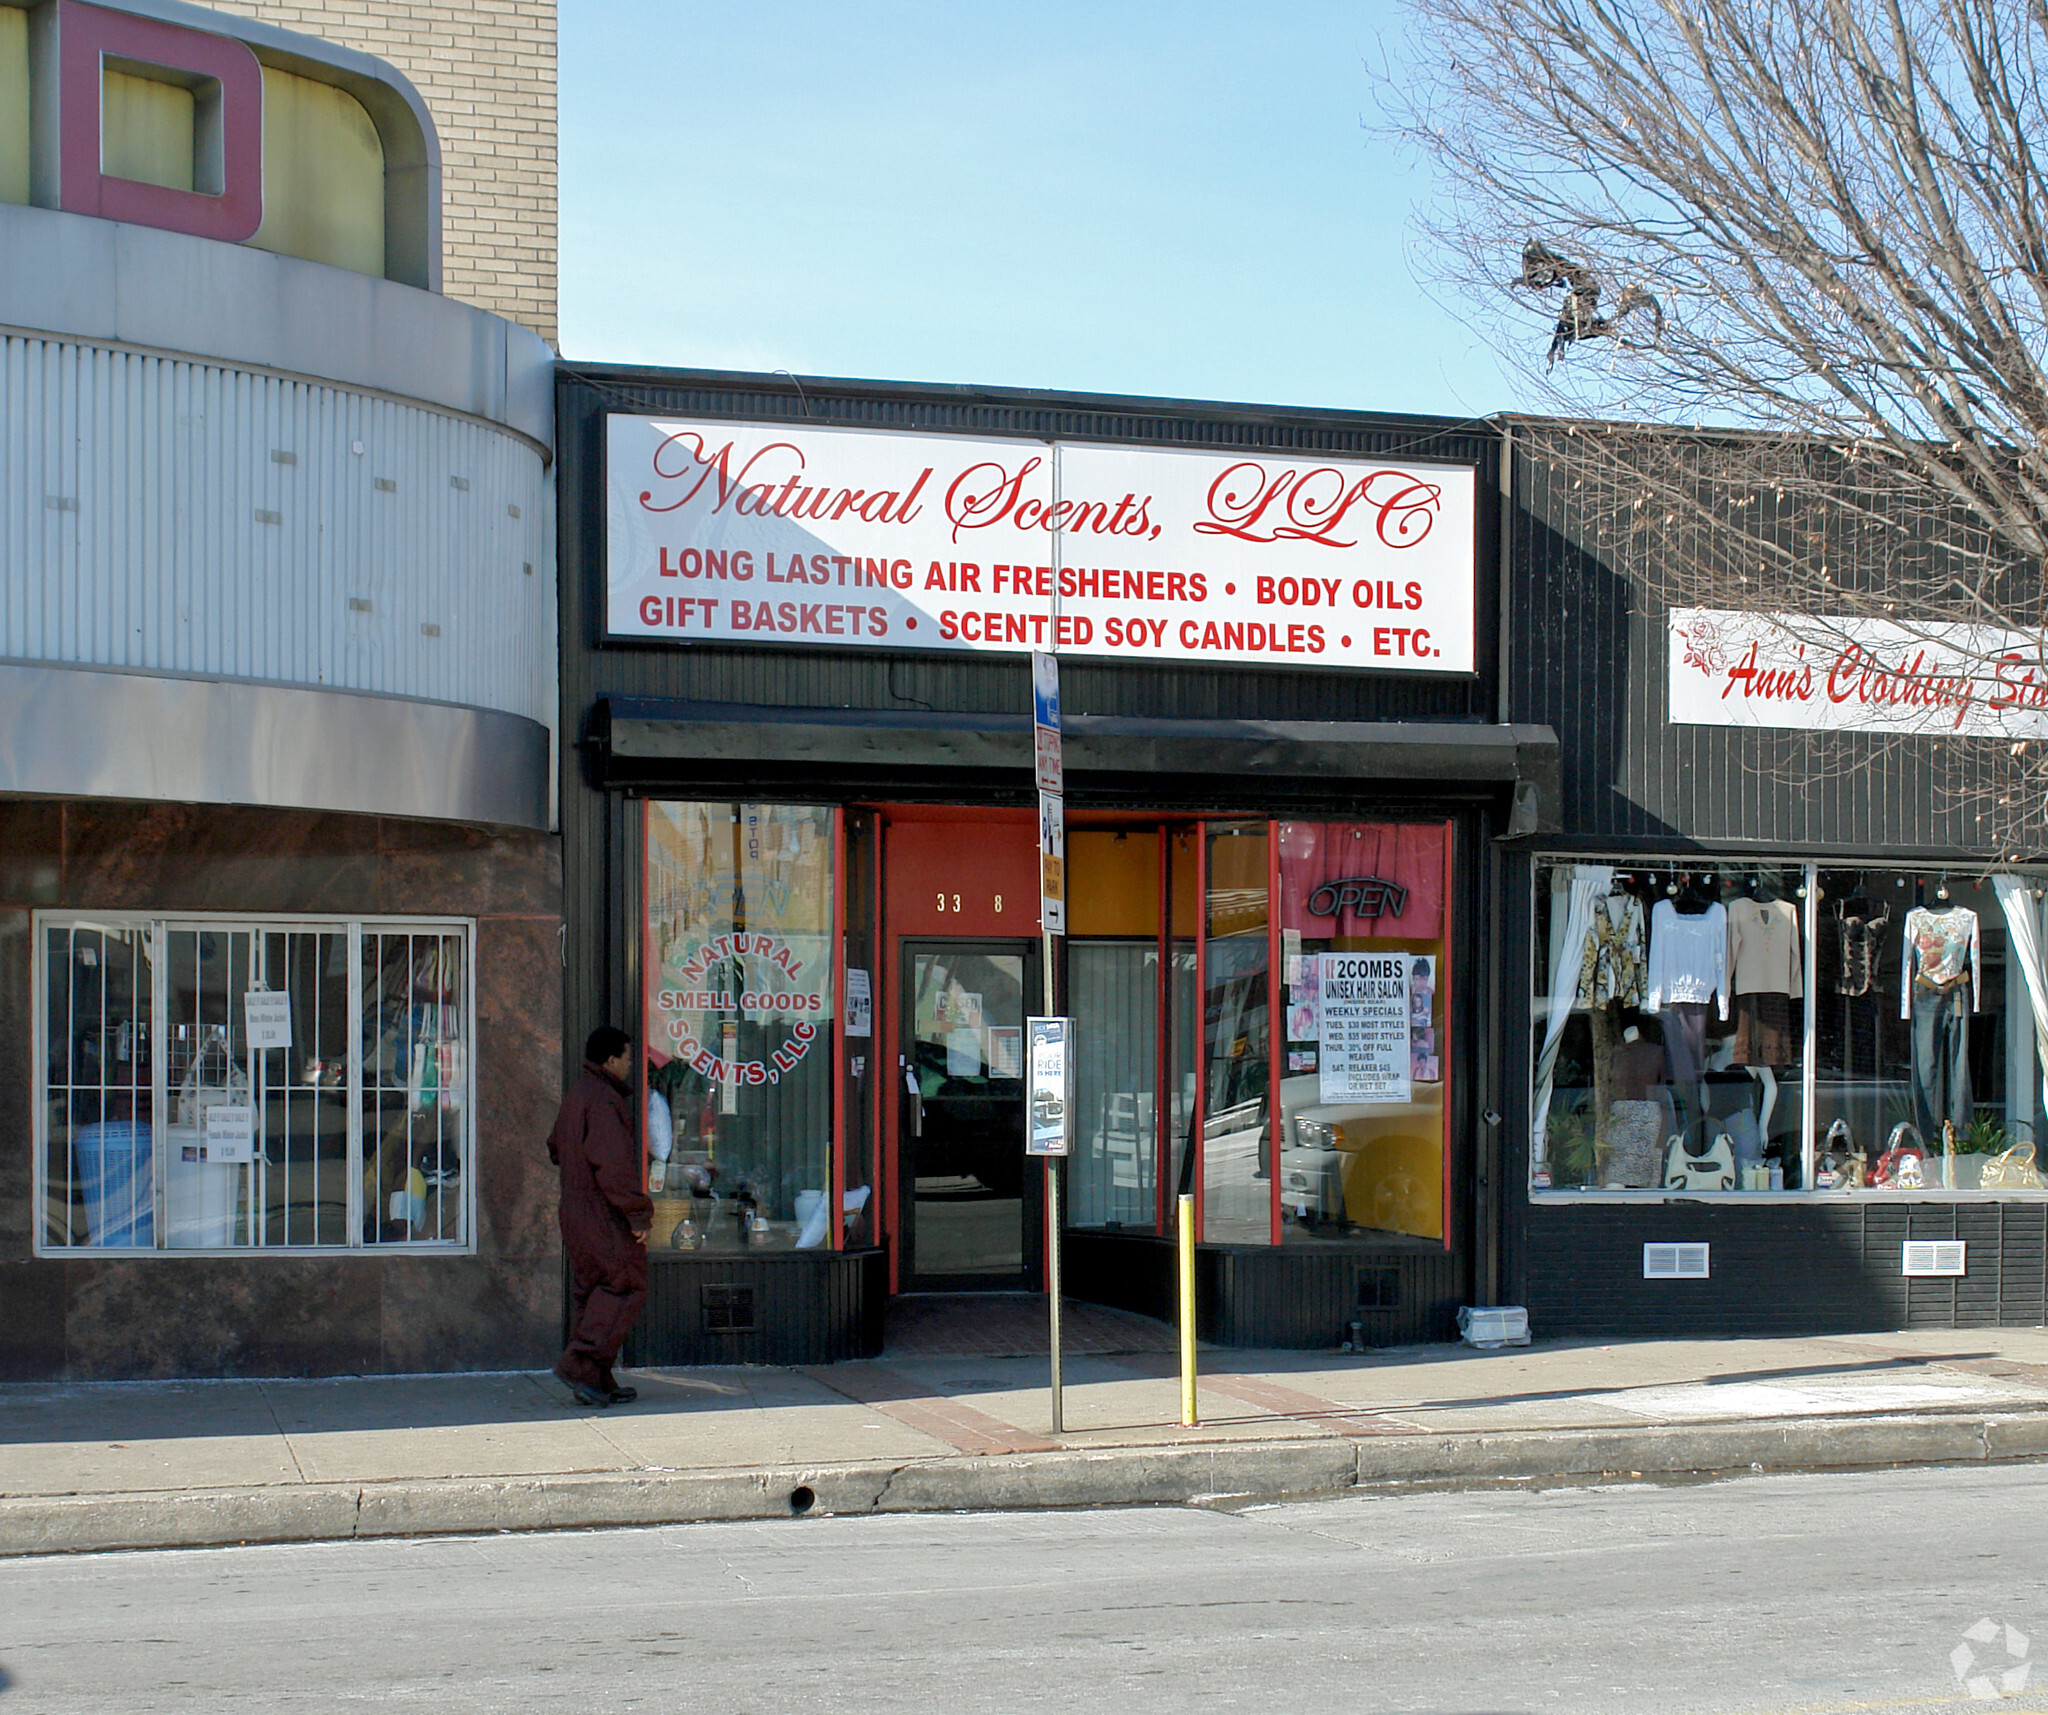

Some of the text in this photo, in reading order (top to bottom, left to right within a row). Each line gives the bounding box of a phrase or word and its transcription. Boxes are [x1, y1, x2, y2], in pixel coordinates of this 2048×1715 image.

[639, 431, 1441, 549] Natural Scents, LLC
[659, 547, 1423, 611] LONG LASTING AIR FRESHENERS BODY OILS
[639, 595, 1441, 657] GIFT BASKETS SCENTED SOY CANDLES ETC.
[1721, 640, 1815, 700] Ann's
[1826, 643, 1975, 731] Clothing
[1309, 886, 1408, 918] OPEN
[681, 933, 804, 982] NATURAL
[1337, 960, 1403, 978] 2COMBS
[1325, 980, 1404, 999] UNISEX HAIR SALON
[659, 991, 822, 1011] SMELL GOODS
[1325, 1007, 1404, 1016] WEEKLY SPECIALS
[1325, 1021, 1345, 1029] TUES.
[1361, 1021, 1379, 1029] MOST
[1380, 1021, 1405, 1029] STYLES
[1361, 1032, 1379, 1040] MOST
[1380, 1032, 1405, 1040] STYLES
[667, 1019, 779, 1084] SCENTS,
[772, 1021, 817, 1073] LLC
[1362, 1043, 1375, 1051] OFF
[1376, 1043, 1393, 1051] FULL
[1037, 1060, 1062, 1069] RIDE
[1348, 1053, 1375, 1061] WEAVES
[1331, 1064, 1345, 1072] SAT.
[1348, 1073, 1380, 1081] INCLUDES
[1374, 1082, 1387, 1090] SET
